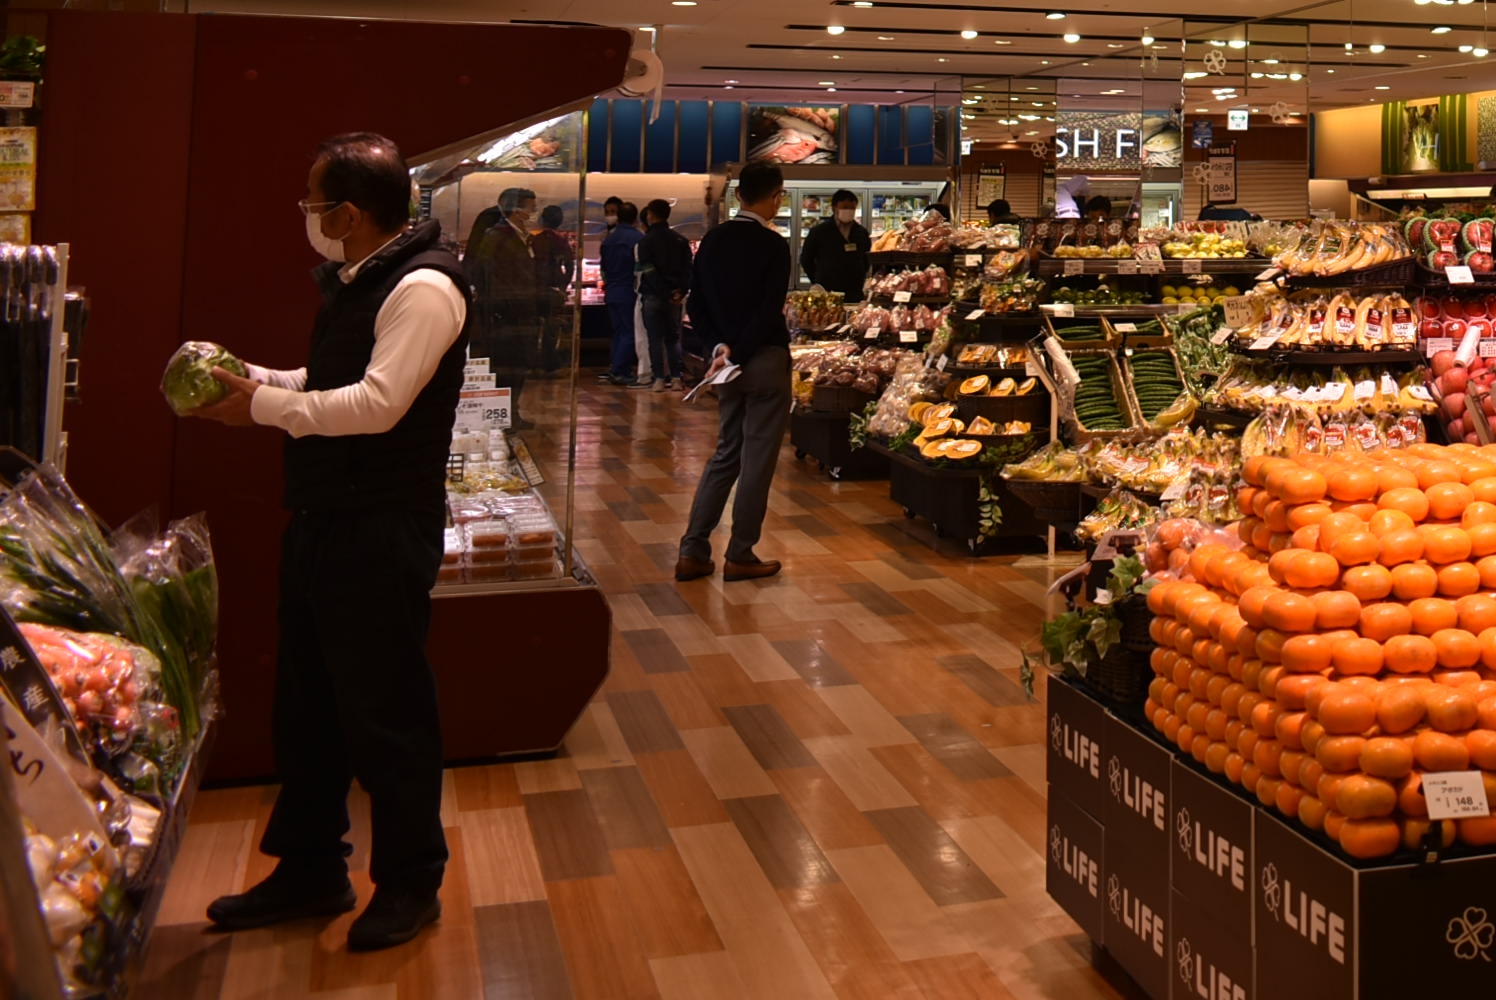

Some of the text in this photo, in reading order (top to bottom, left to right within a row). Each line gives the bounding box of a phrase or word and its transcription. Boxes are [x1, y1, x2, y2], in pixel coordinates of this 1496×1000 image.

[486, 408, 508, 420] 258
[1064, 725, 1099, 779] LIFE
[1122, 768, 1165, 831] LIFE
[1455, 796, 1474, 806] 148
[1063, 837, 1098, 898] LIFE
[1195, 820, 1244, 892] LIFE
[1122, 895, 1164, 957] LIFE
[1285, 879, 1345, 964] LIFE
